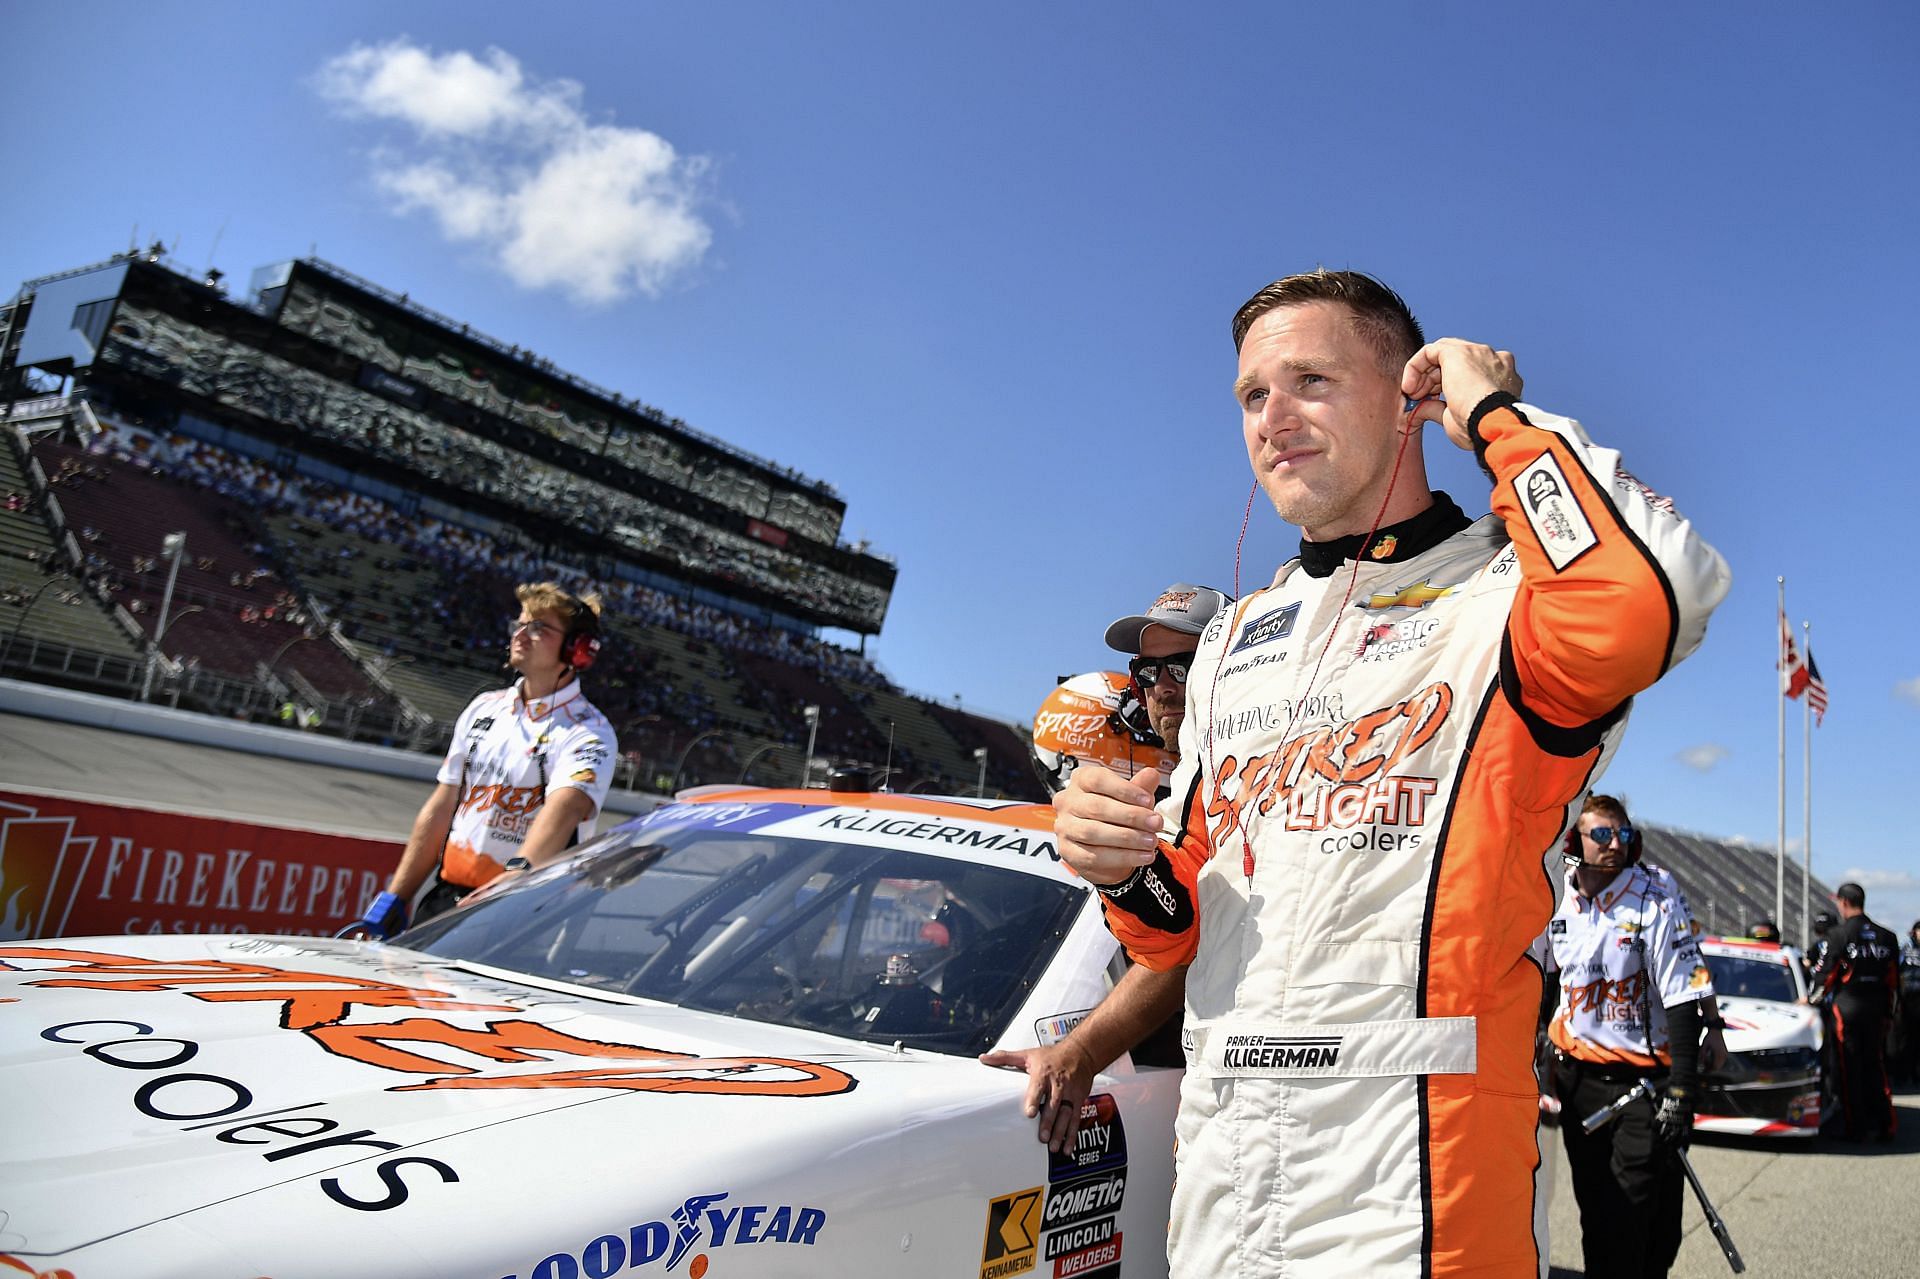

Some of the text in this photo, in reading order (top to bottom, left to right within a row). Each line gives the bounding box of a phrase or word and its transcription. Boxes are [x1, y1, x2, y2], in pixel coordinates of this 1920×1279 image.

[1244, 618, 1286, 644] xfinity
[1400, 618, 1439, 639] BIG
[1280, 692, 1348, 723] VODKA
[1034, 710, 1107, 740] SPIKED
[1056, 730, 1097, 748] LIGHT
[1207, 681, 1453, 860] SPIKED
[1284, 776, 1438, 832] LIGHT
[817, 813, 1060, 862] KLIGERMAN
[1320, 826, 1422, 854] coolers
[1227, 1036, 1264, 1047] PARKER
[1224, 1048, 1340, 1068] KLIGERMAN
[40, 1020, 459, 1212] coolers
[1081, 1104, 1098, 1119] SCAR
[1072, 1120, 1110, 1160] inity
[1078, 1151, 1100, 1166] SERIES
[1046, 1178, 1124, 1221] COMETIC
[502, 1206, 826, 1279] OODYEAR
[1048, 1221, 1112, 1256] LINCOLN
[981, 1254, 1033, 1279] KENNAMETAL
[1061, 1244, 1117, 1275] WELDERS
